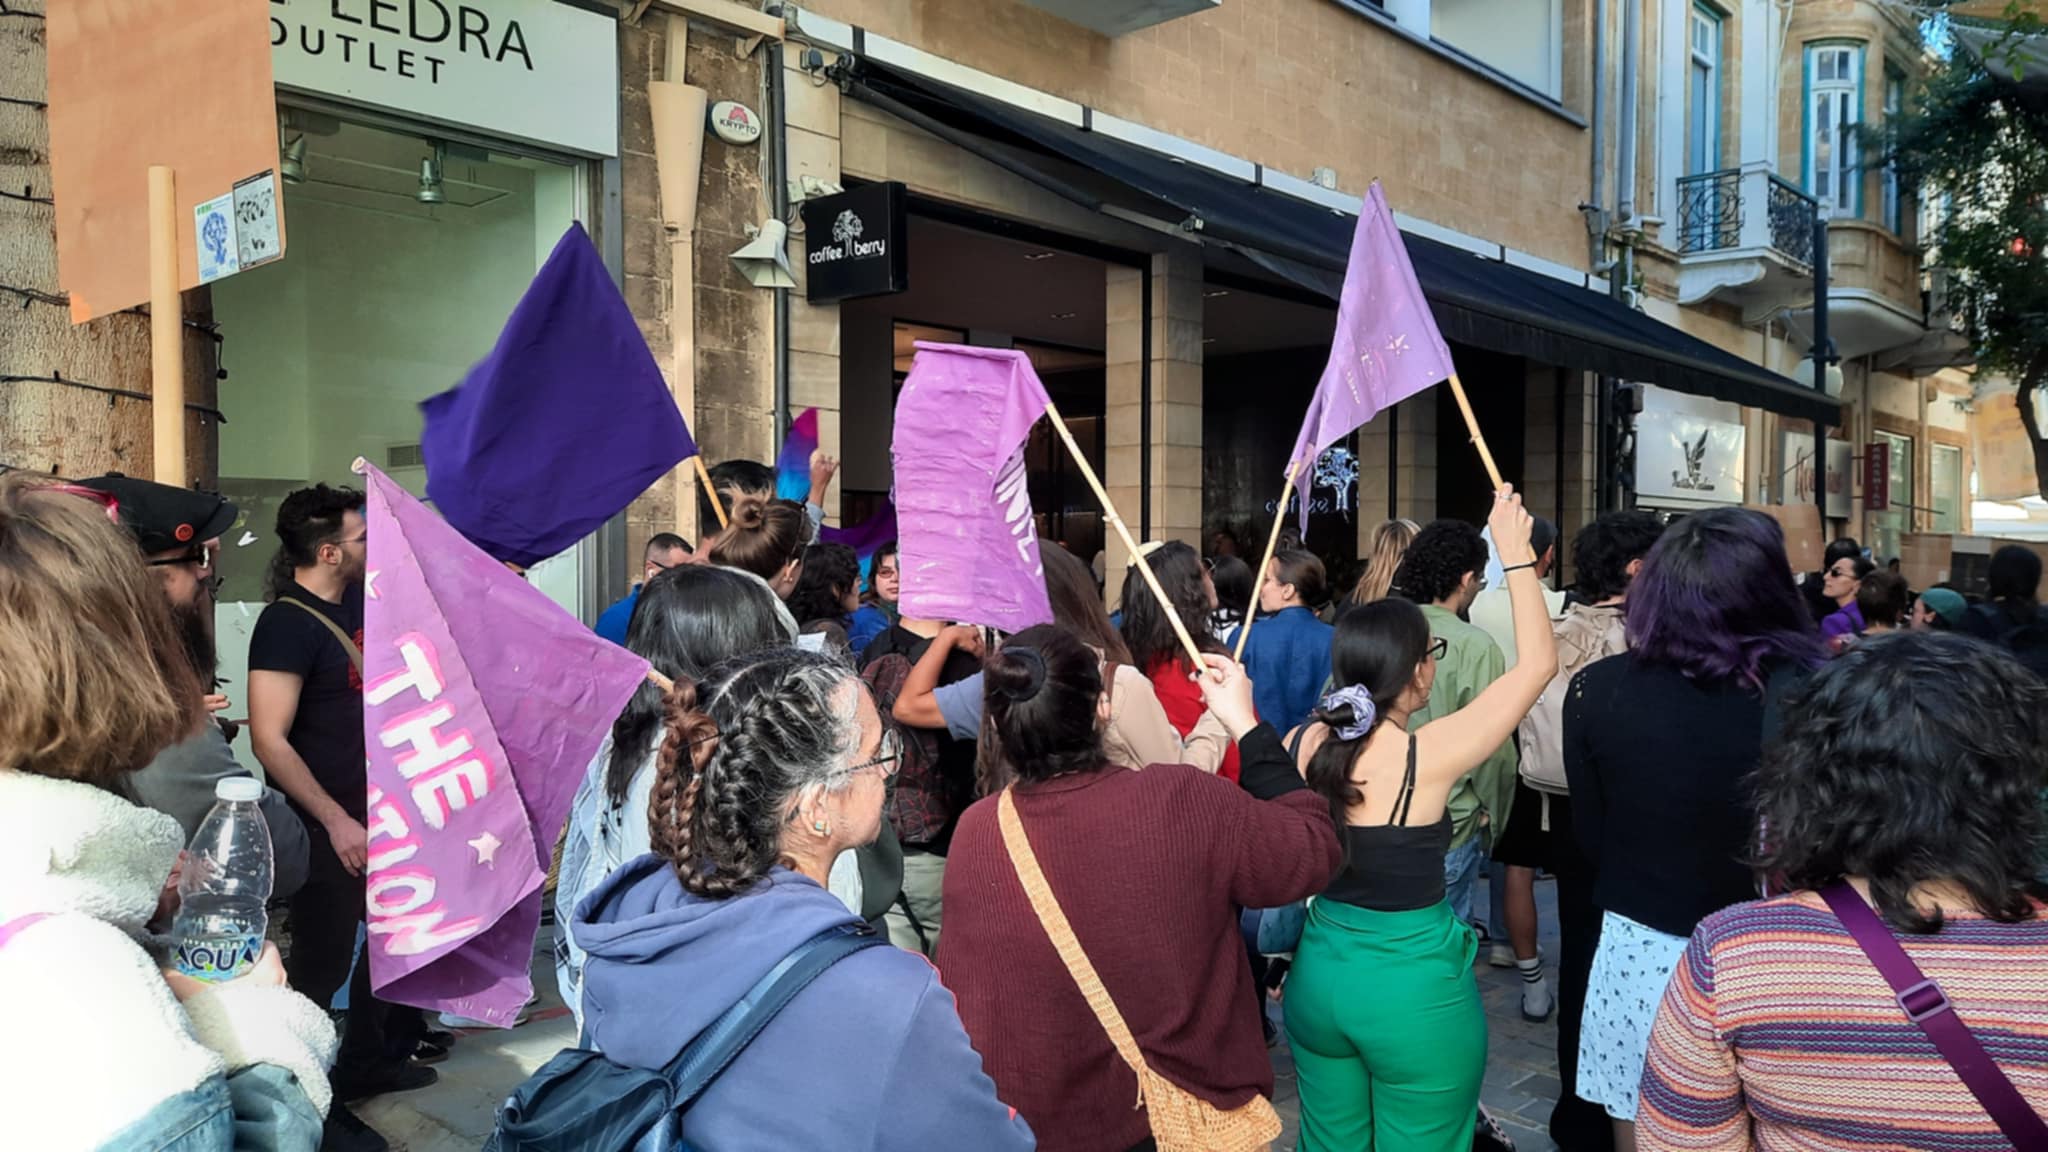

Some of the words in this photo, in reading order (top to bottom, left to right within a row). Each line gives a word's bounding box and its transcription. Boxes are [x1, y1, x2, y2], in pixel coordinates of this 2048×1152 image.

[719, 118, 757, 135] KRYPTO
[809, 245, 842, 264] coffee
[854, 239, 885, 256] berry
[363, 631, 496, 832] THE
